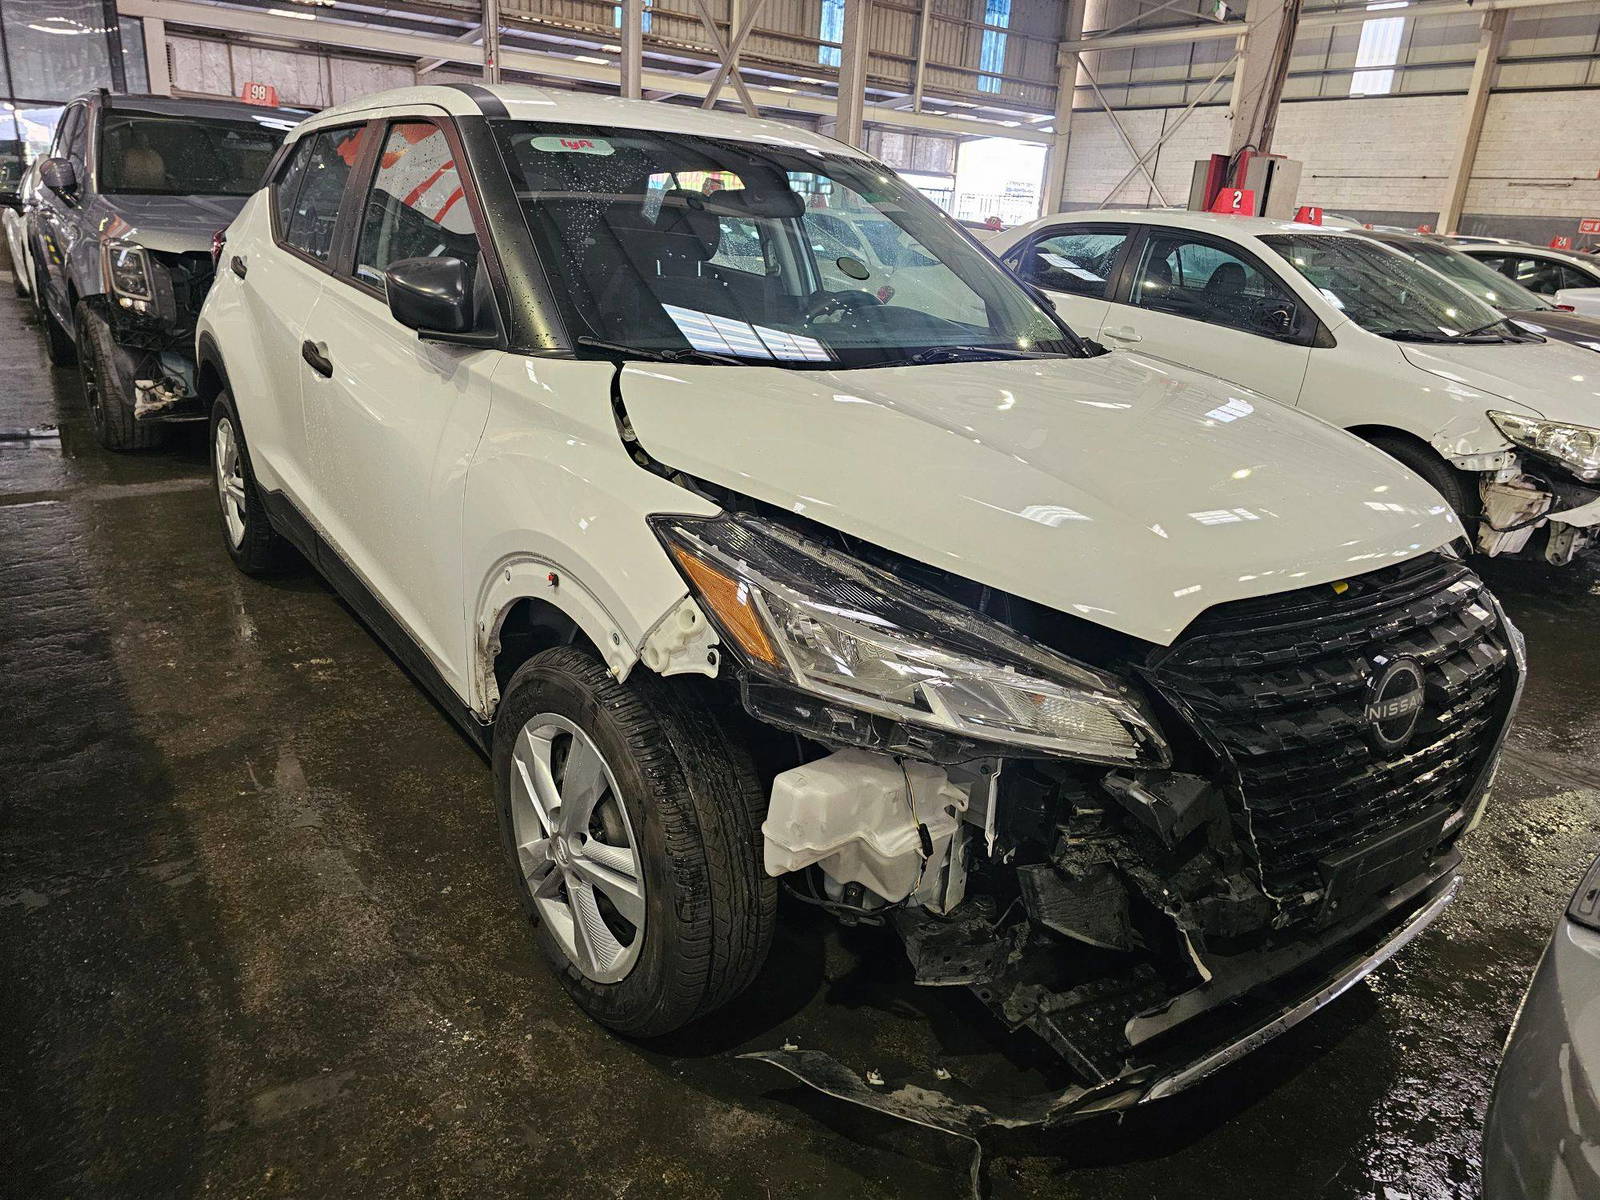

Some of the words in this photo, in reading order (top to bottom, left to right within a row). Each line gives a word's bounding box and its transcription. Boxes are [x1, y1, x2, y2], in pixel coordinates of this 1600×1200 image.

[251, 85, 266, 100] 98
[1232, 190, 1242, 208] 2
[1308, 207, 1315, 221] 4
[1369, 694, 1423, 720] NISSAN
